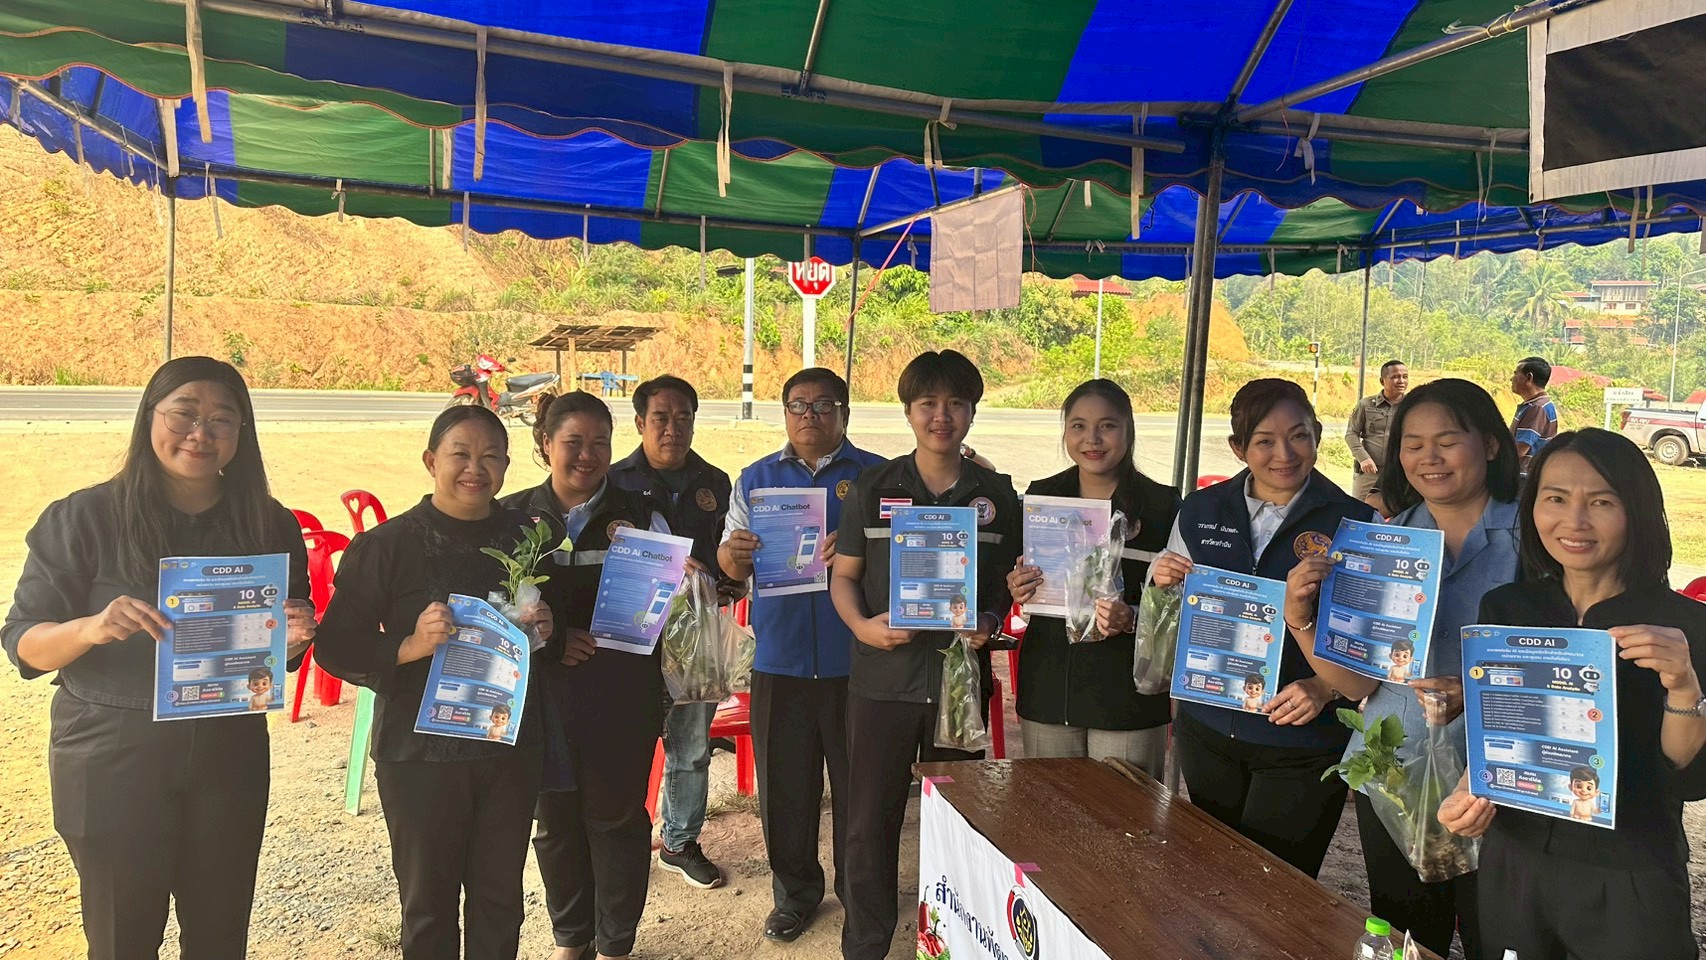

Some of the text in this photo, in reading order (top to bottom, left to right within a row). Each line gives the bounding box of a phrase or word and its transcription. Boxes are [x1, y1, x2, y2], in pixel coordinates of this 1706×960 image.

[796, 261, 830, 290] หยุด
[1028, 514, 1048, 523] CDD
[611, 545, 630, 555] CDD
[642, 550, 673, 562] Chatbot
[1395, 560, 1409, 569] 10
[240, 589, 255, 600] 10
[1244, 602, 1257, 612] 10
[486, 611, 498, 621] CDD
[500, 638, 510, 649] 10
[1518, 637, 1555, 646] CDD AI
[1552, 667, 1572, 679] 10
